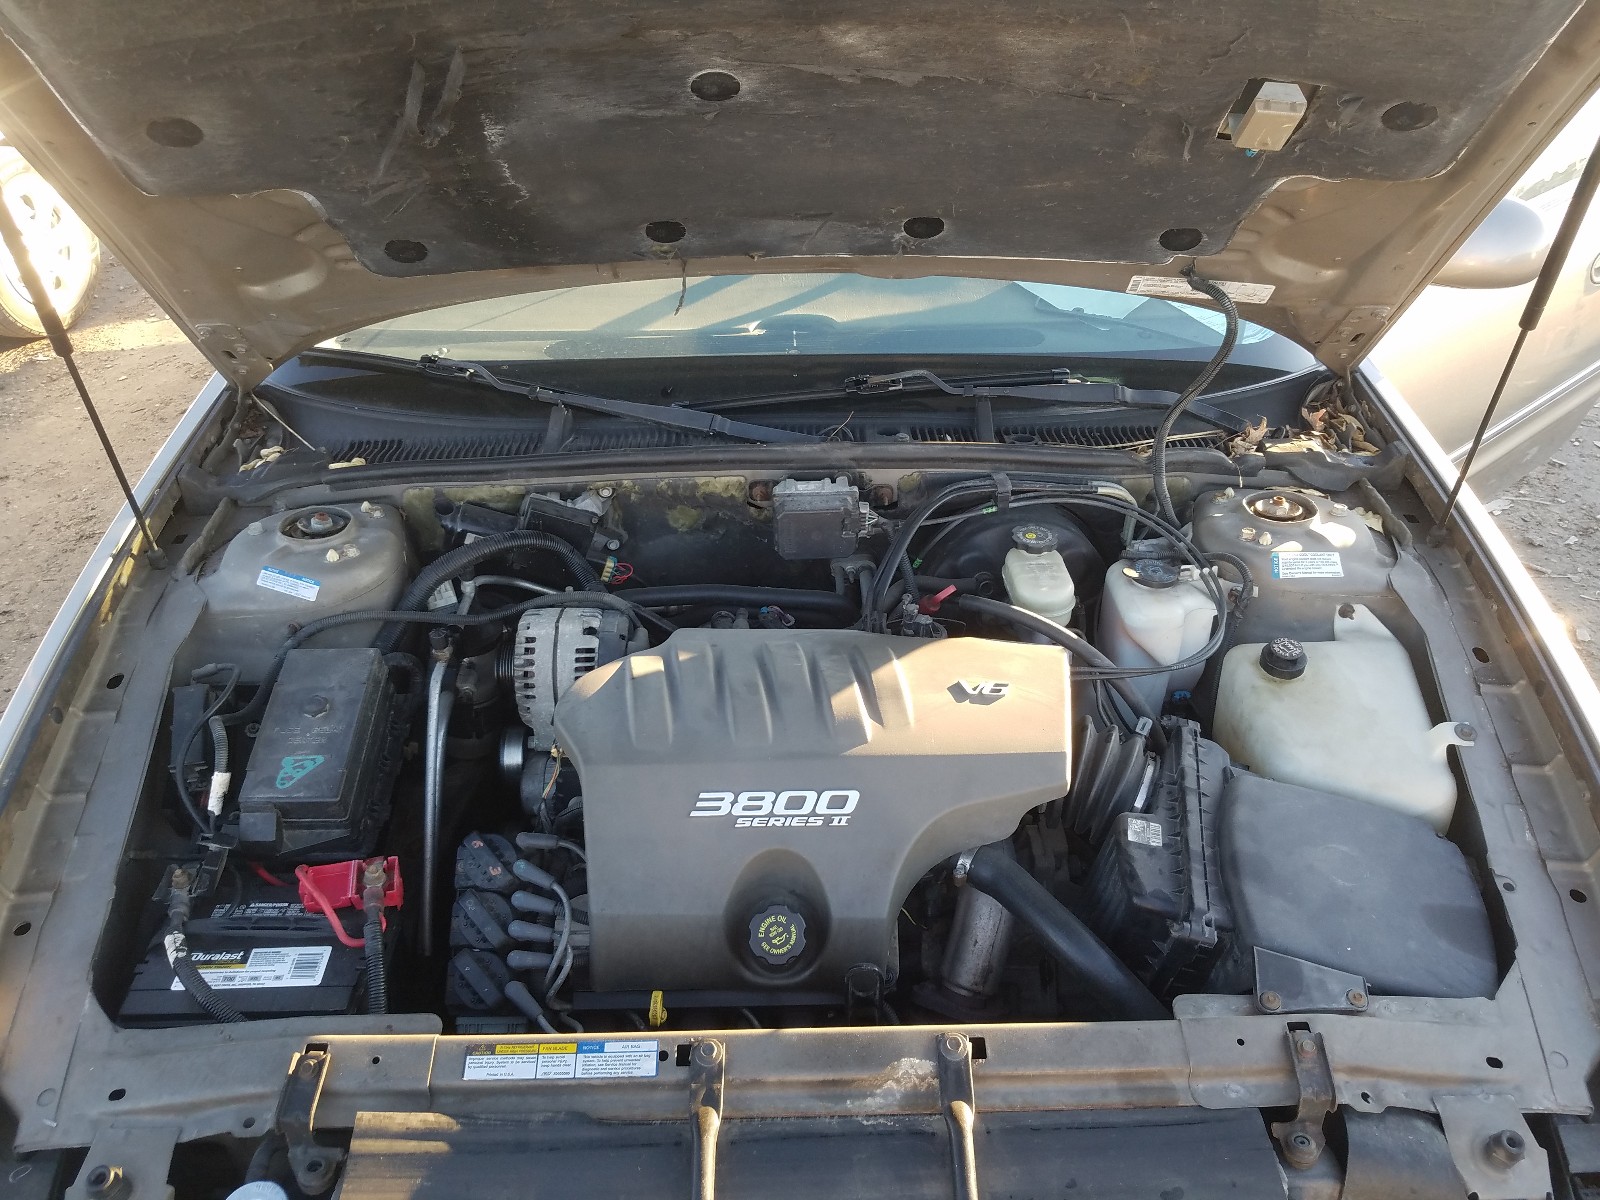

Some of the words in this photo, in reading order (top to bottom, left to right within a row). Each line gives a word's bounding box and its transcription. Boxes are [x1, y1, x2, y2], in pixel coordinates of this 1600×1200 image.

[948, 680, 1010, 703] V6
[690, 789, 860, 817] 3800
[735, 816, 824, 828] SERIES
[828, 815, 852, 827] II
[758, 915, 776, 938] ENGINE
[777, 914, 787, 924] OIL
[191, 950, 245, 961] Duralast
